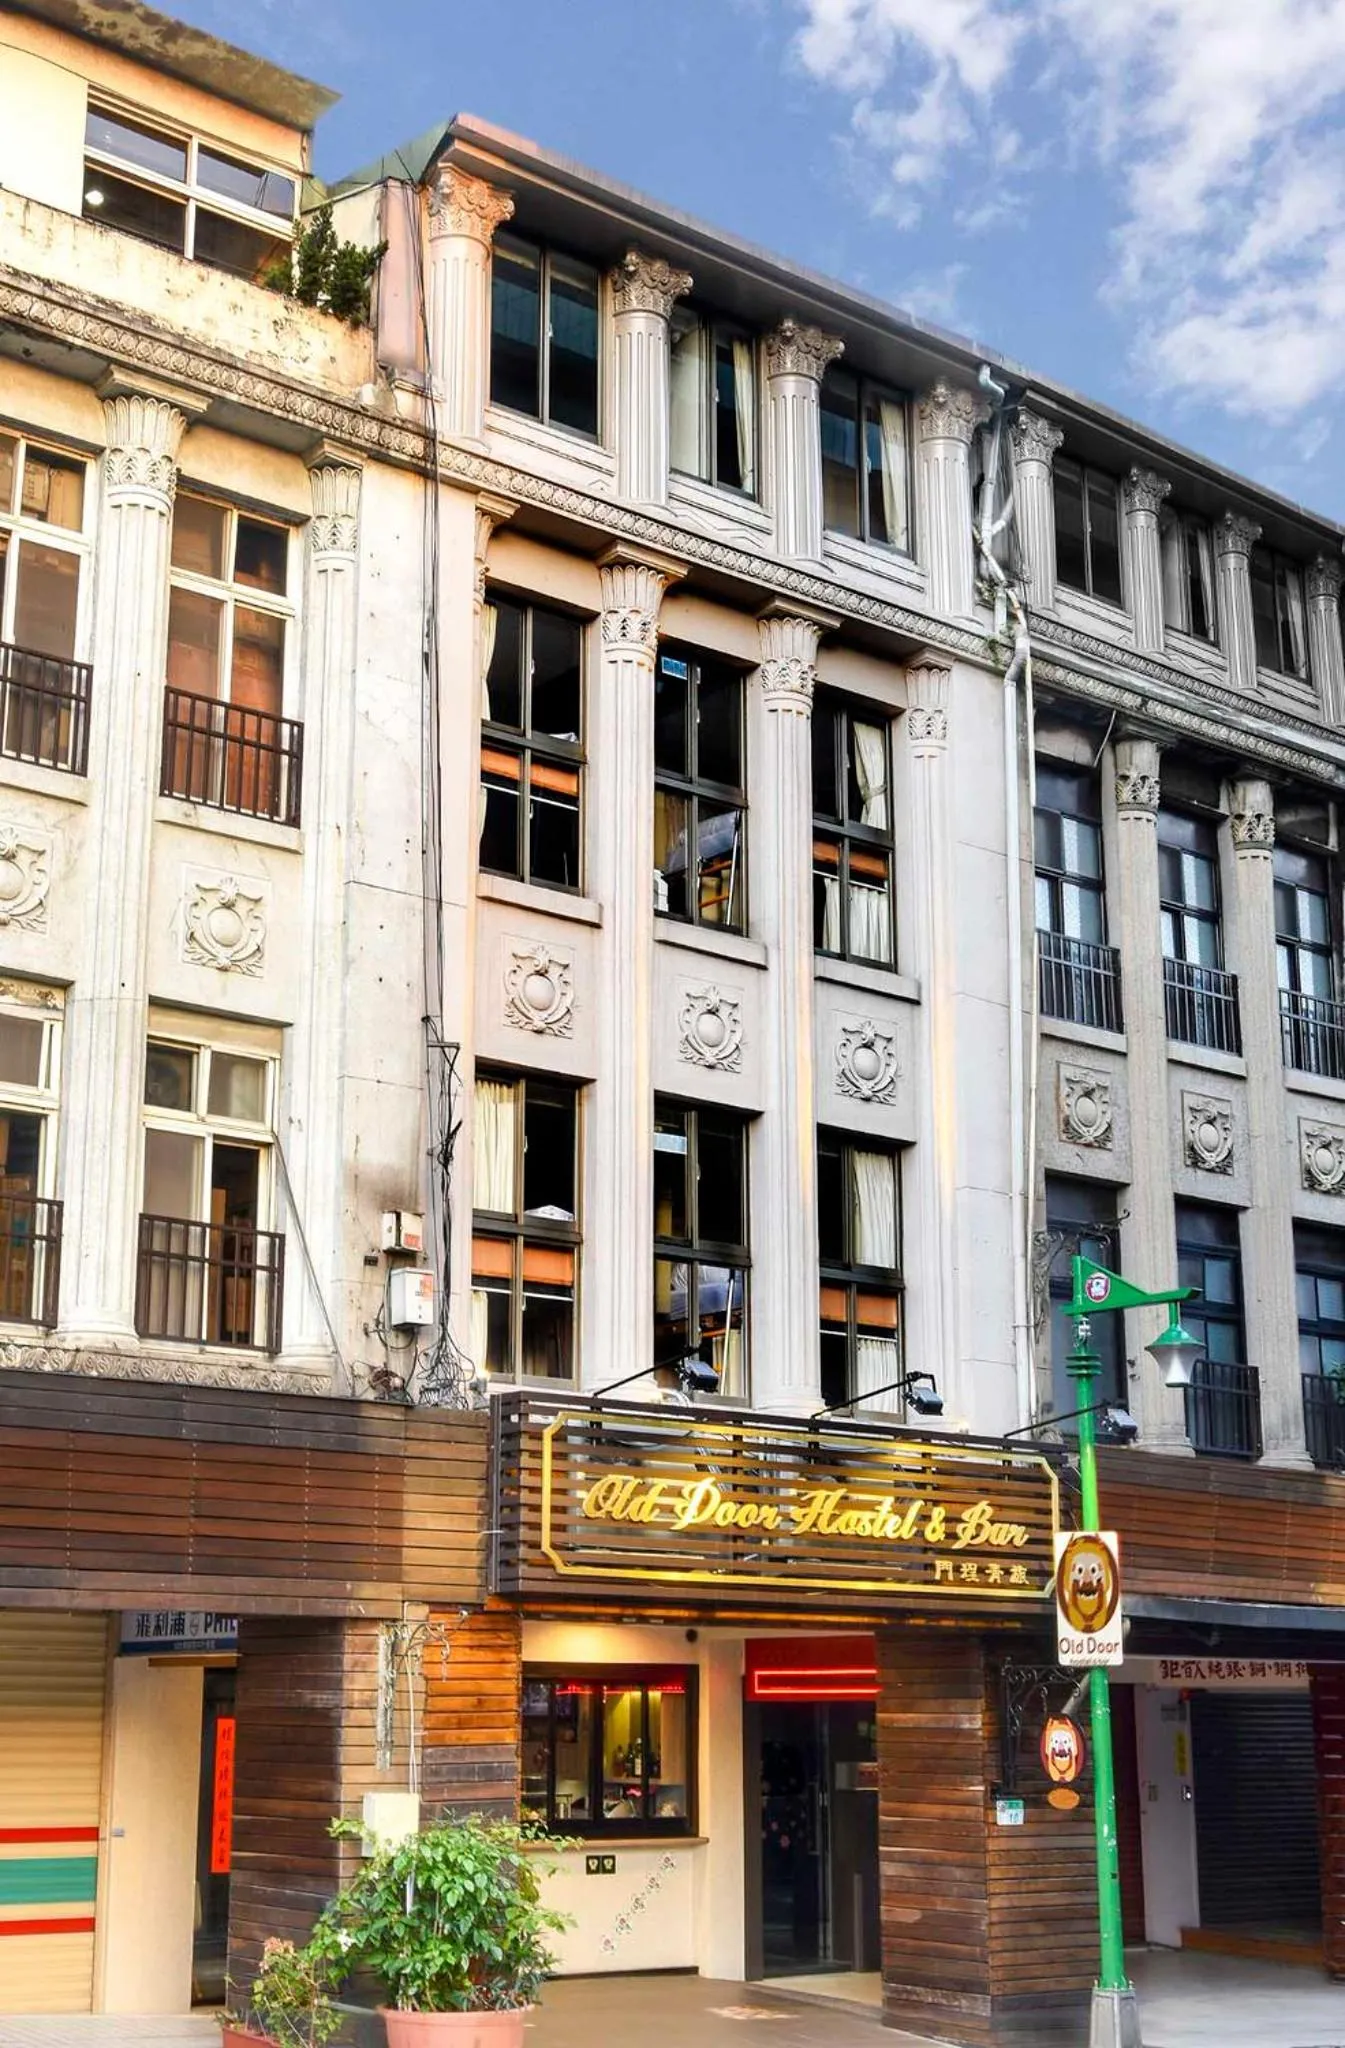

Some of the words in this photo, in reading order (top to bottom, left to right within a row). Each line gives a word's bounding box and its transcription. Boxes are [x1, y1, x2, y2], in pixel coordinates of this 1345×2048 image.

[583, 1475, 668, 1522] Old
[670, 1477, 781, 1530] Door
[790, 1488, 924, 1540] Hostel
[924, 1506, 945, 1542] &
[952, 1500, 1029, 1549] Bar
[1059, 1637, 1083, 1654] Old
[1087, 1637, 1119, 1654] Door
